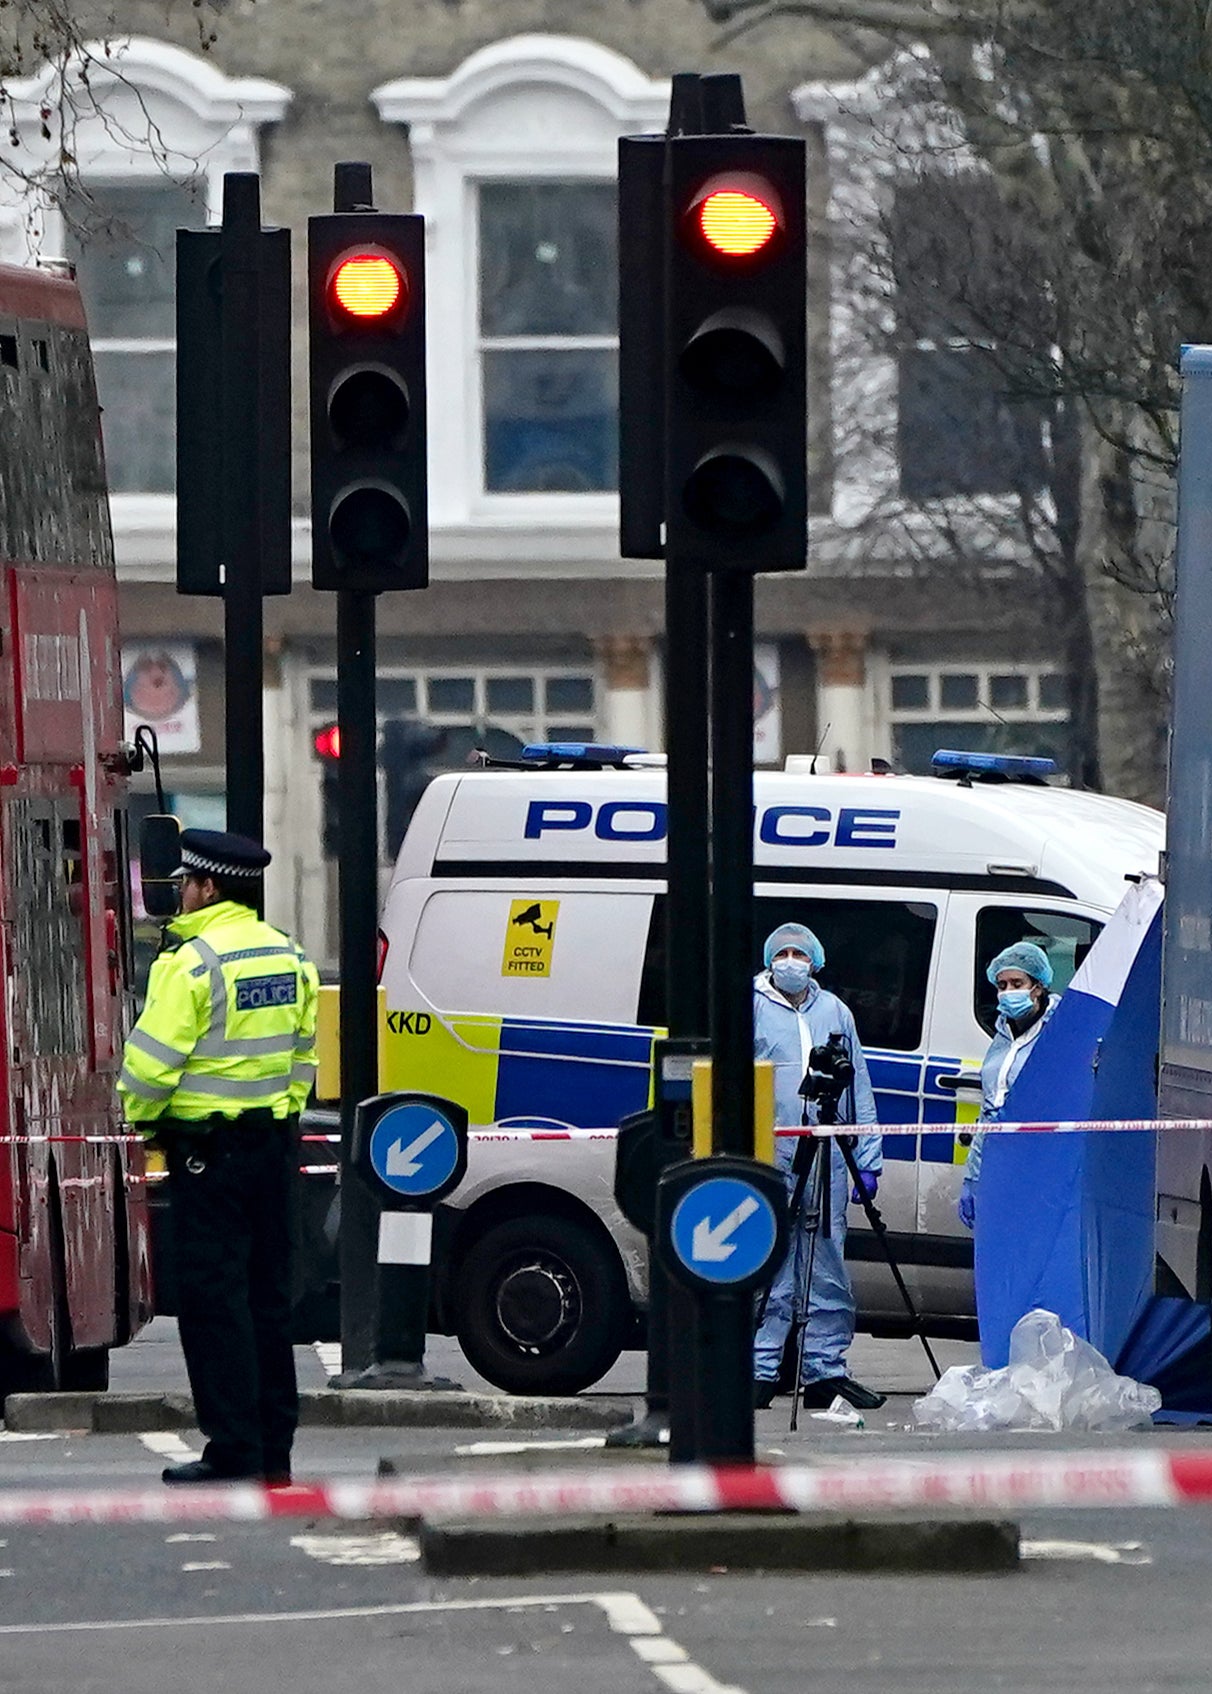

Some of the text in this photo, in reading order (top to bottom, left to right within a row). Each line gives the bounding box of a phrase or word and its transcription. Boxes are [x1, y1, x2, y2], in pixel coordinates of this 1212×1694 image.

[524, 800, 902, 849] POCE
[514, 946, 543, 958] CCTV
[508, 961, 545, 972] FITTED
[237, 984, 296, 1010] POLICE
